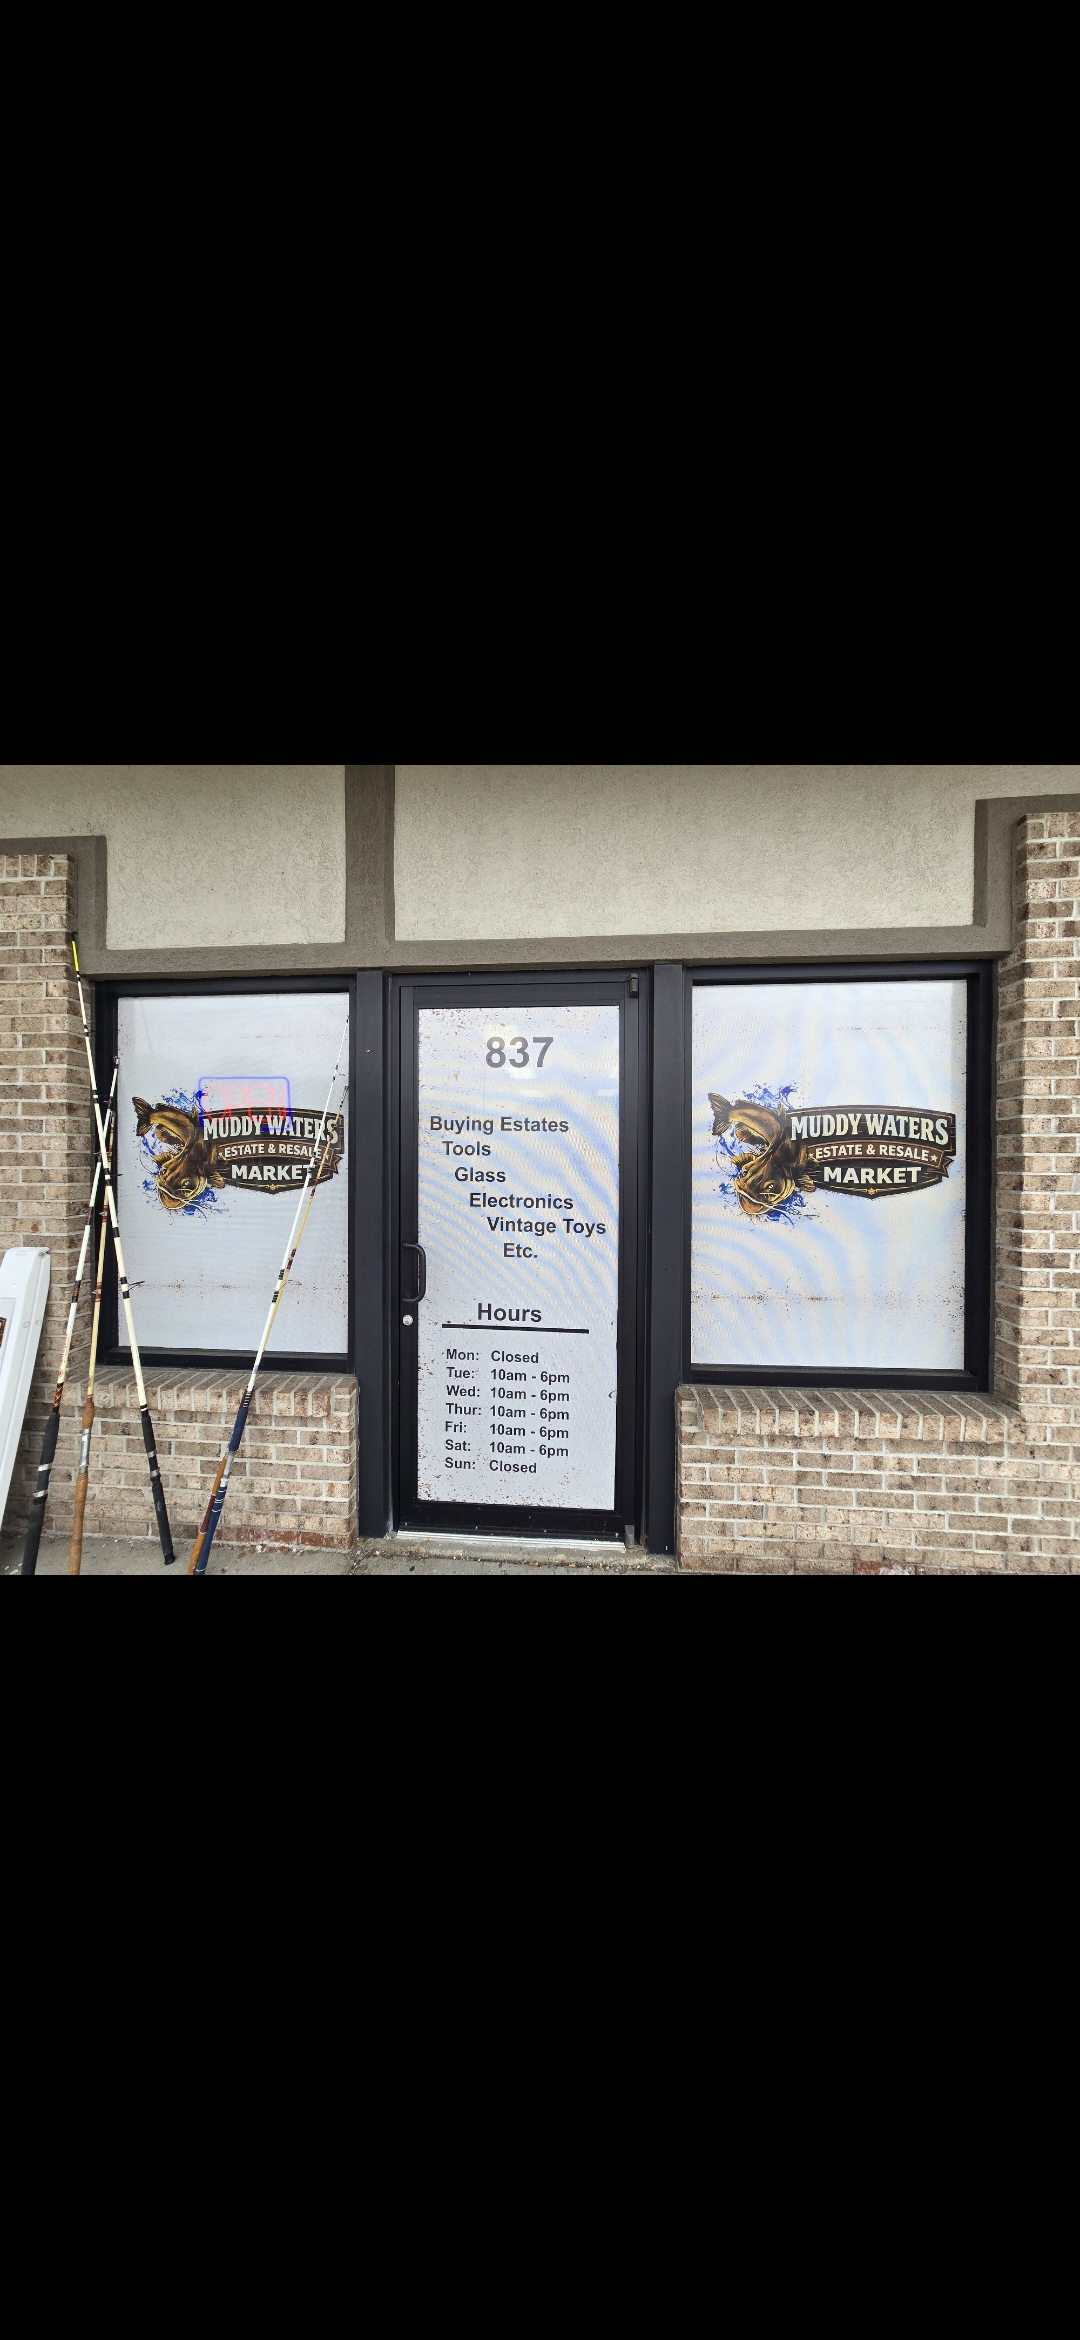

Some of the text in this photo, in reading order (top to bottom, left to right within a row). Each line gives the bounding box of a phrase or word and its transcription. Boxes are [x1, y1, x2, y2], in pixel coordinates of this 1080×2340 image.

[486, 1036, 553, 1068] 837
[203, 1085, 287, 1122] OPEN
[203, 1115, 339, 1144] MUDDY WATERS
[430, 1116, 569, 1134] Buying Estates
[791, 1114, 949, 1144] MUDDY WATERS
[224, 1144, 264, 1158] ESTATE
[268, 1144, 276, 1153] &
[442, 1141, 491, 1156] Tools
[816, 1144, 929, 1161] ESTATE & RESALE
[455, 1167, 506, 1182] Glass
[824, 1166, 922, 1184] MARKET
[470, 1193, 573, 1209] Electronics
[487, 1217, 606, 1238] Vintage Toys
[504, 1243, 538, 1258] Etc.
[477, 1303, 542, 1322] Hours
[446, 1349, 539, 1363] Mon: Closed
[447, 1367, 475, 1379] Tue:
[491, 1369, 526, 1381] 10am
[540, 1371, 570, 1384] 6pm
[446, 1385, 480, 1397] Wed:
[491, 1388, 526, 1400] 10am
[540, 1390, 570, 1402] 6pm
[446, 1403, 481, 1415] Thur:
[490, 1406, 526, 1418] 10am
[540, 1408, 569, 1421] 6pm
[445, 1422, 467, 1433] Fri:
[490, 1424, 525, 1437] 10am
[540, 1426, 569, 1439] 6pm
[445, 1439, 471, 1452] Sat:
[490, 1442, 525, 1454] 10am
[539, 1445, 569, 1457] 6pm
[445, 1458, 537, 1473] Sun: Closed
